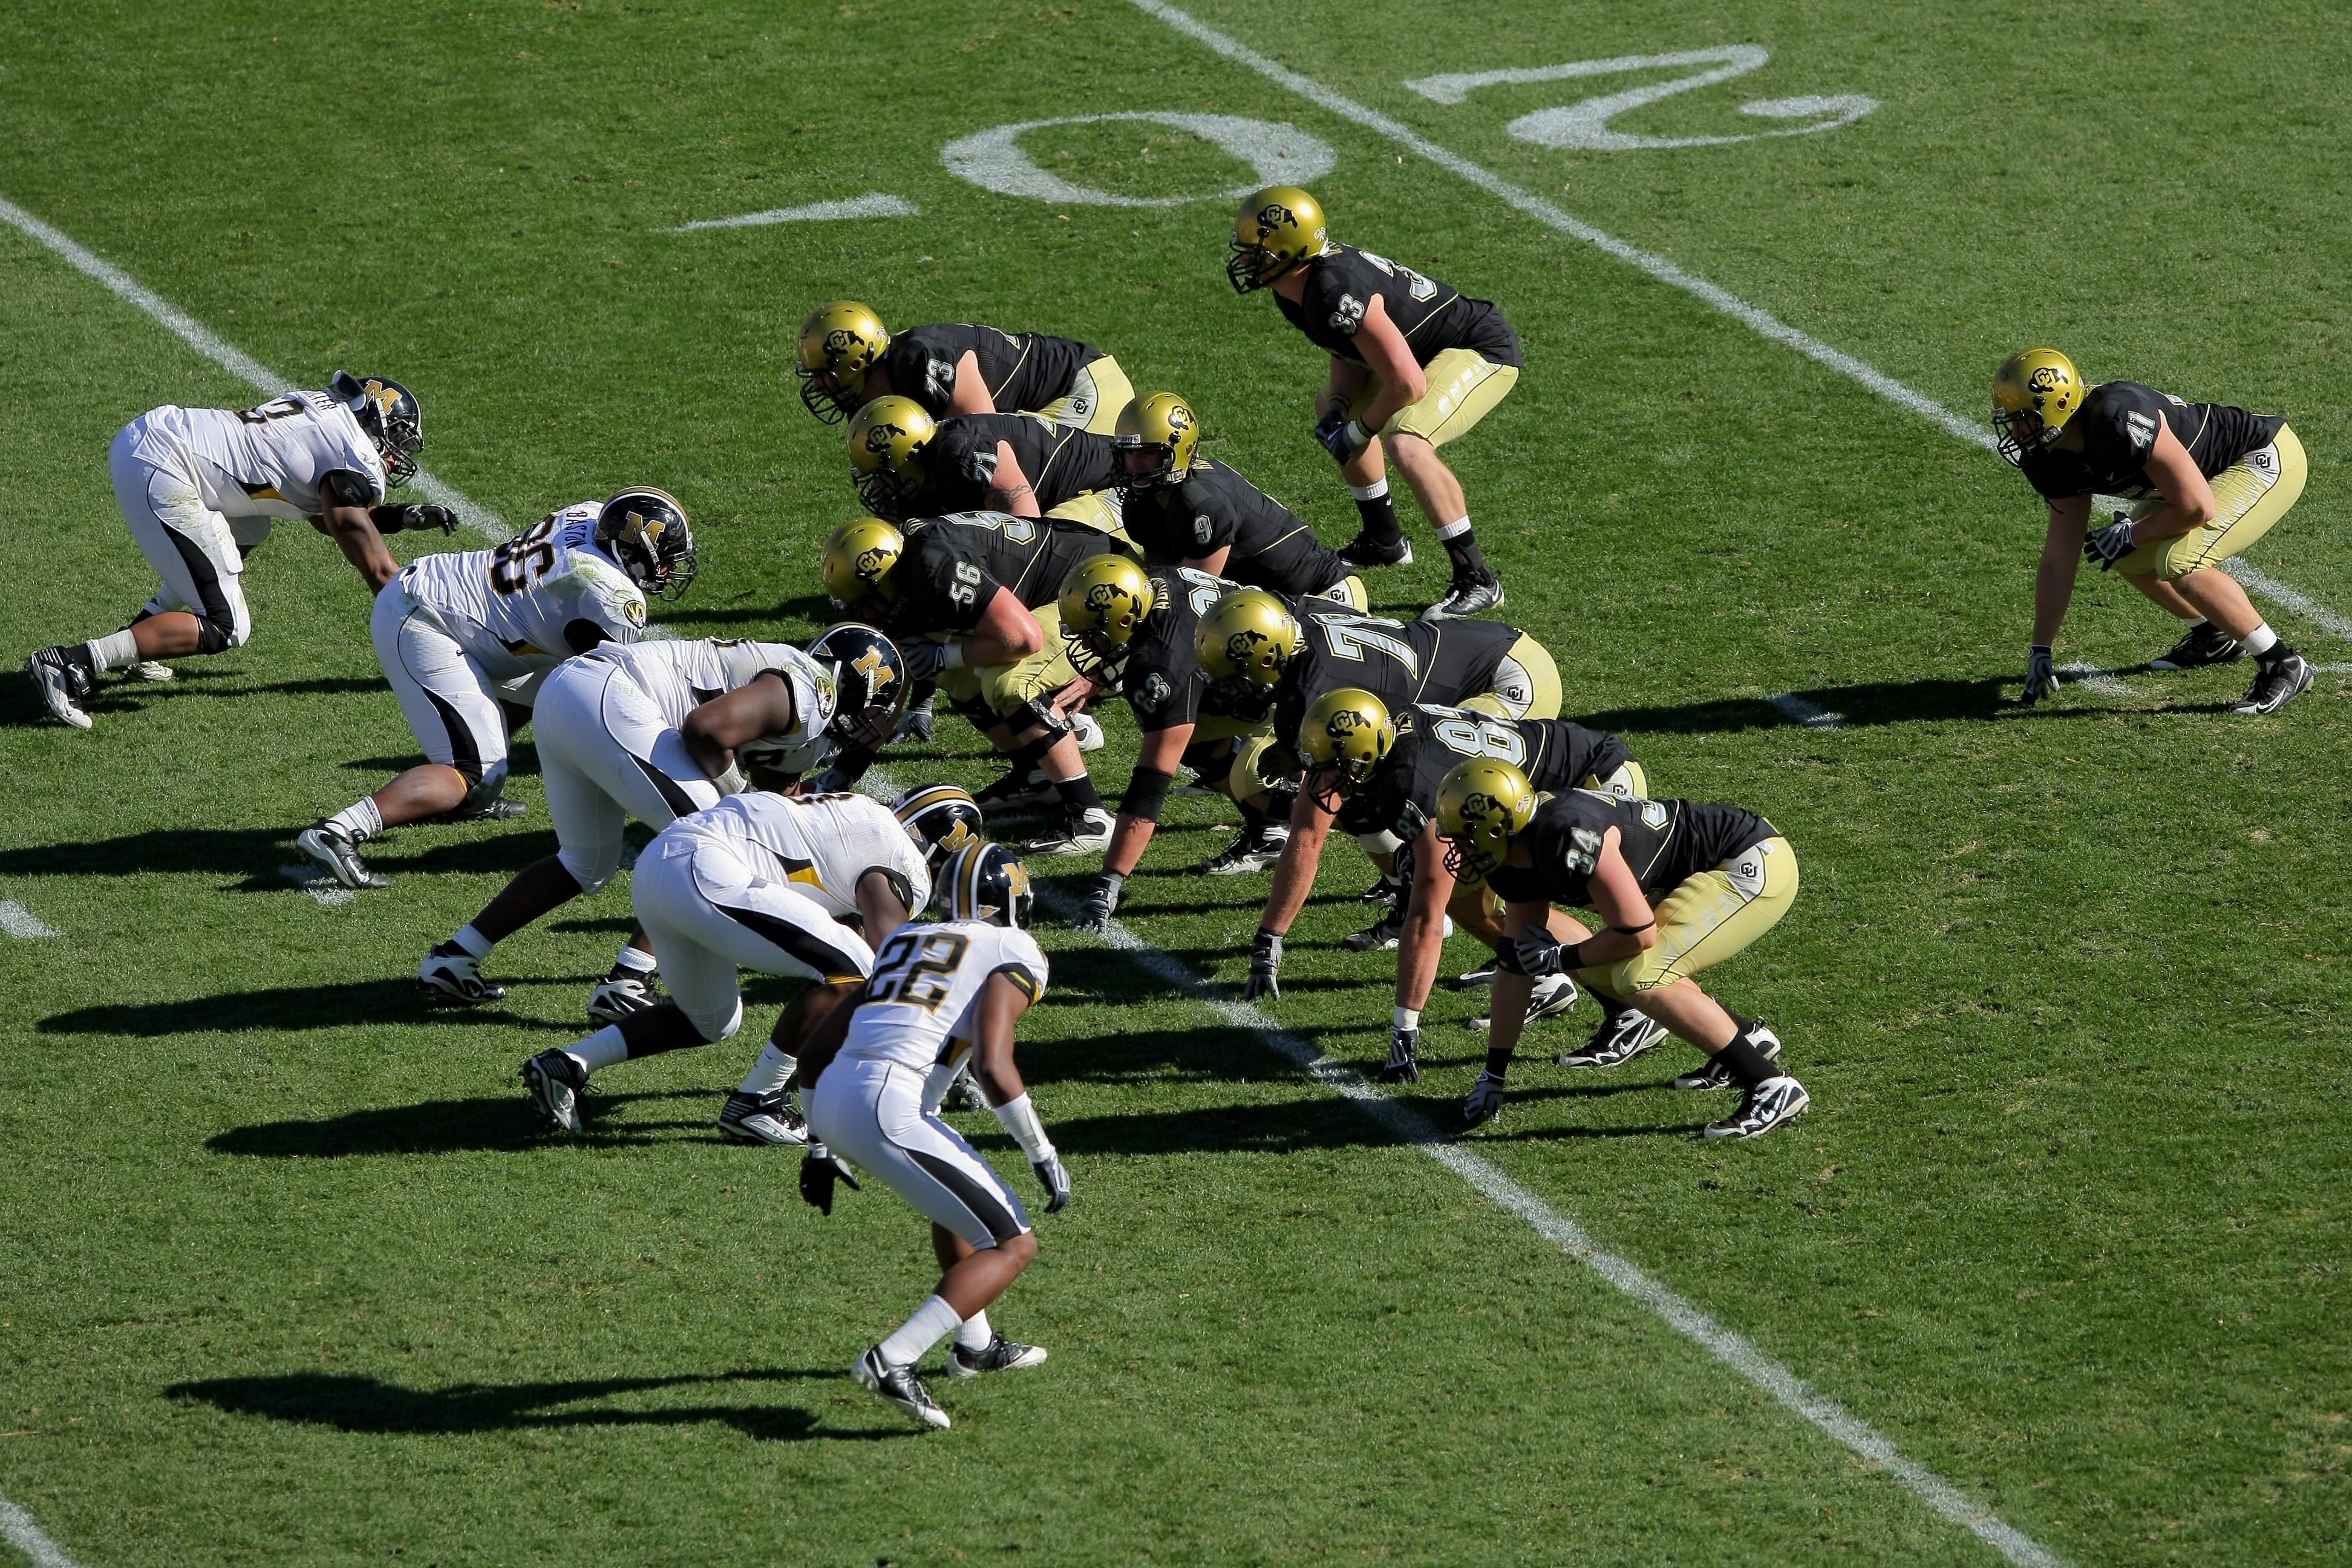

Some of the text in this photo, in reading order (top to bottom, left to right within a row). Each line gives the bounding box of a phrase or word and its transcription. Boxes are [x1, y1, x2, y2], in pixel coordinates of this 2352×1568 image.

[1329, 293, 1365, 334] 33
[925, 358, 955, 403] 73
[1073, 399, 1088, 414] CU
[2126, 410, 2155, 448] 41
[2254, 453, 2271, 468] CU
[565, 511, 587, 549] BASTON
[619, 511, 665, 551] M
[1194, 514, 1213, 545] 9
[949, 560, 982, 605] 56
[851, 645, 895, 694] M
[1564, 826, 1602, 876] 34
[1739, 862, 1757, 877] CU
[865, 932, 970, 1015] 22
